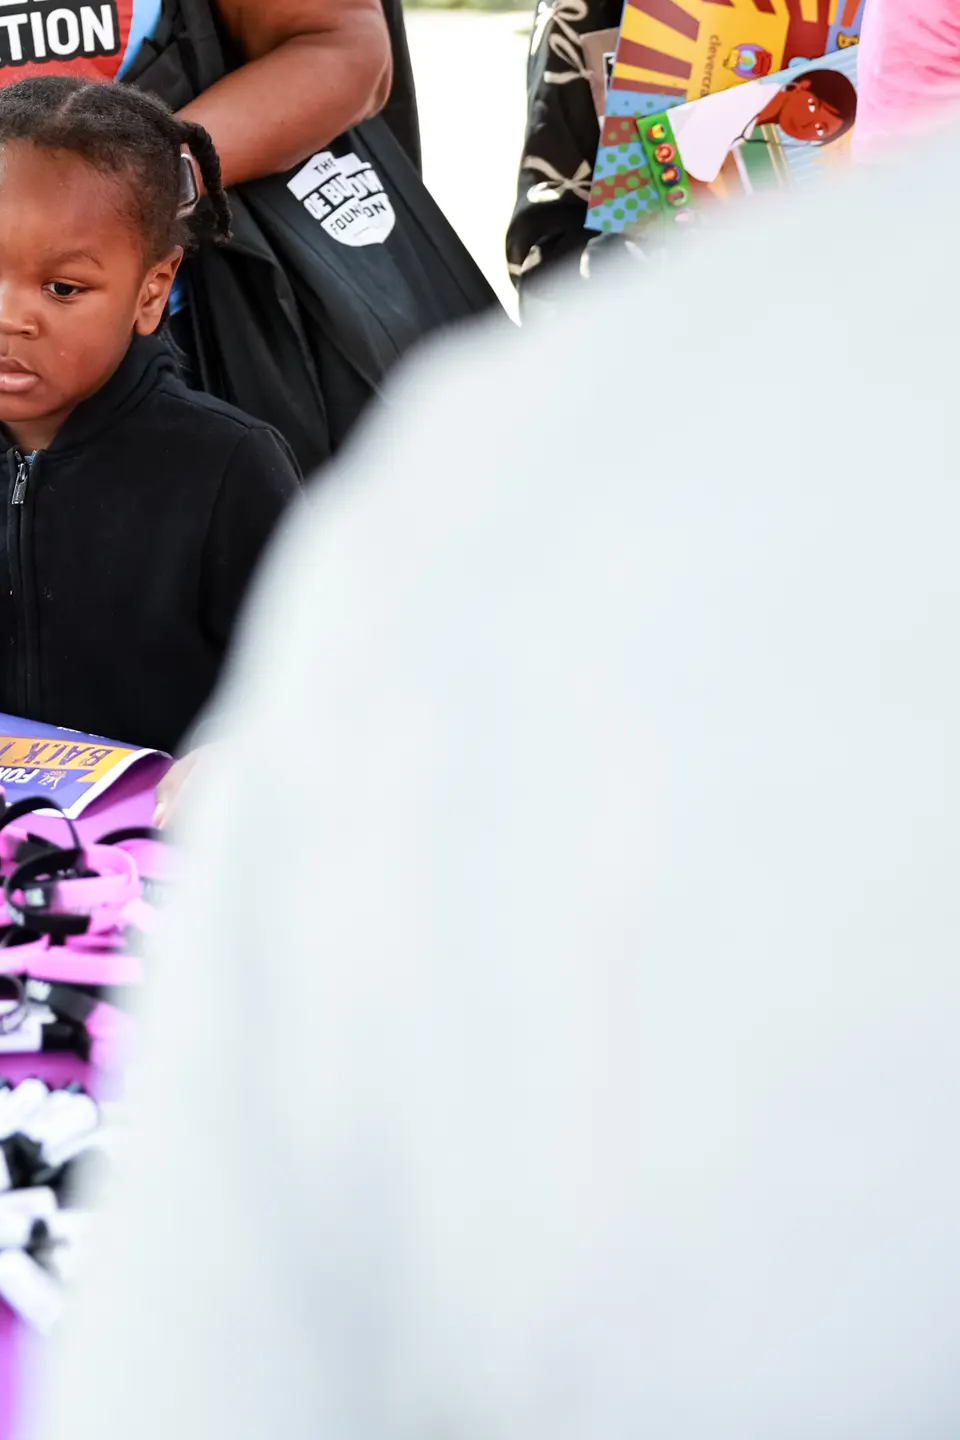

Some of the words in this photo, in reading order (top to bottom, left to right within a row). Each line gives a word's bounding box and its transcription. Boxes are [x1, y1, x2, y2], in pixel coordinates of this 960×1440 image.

[313, 157, 337, 176] THE
[329, 199, 387, 236] FOUNON
[18, 740, 115, 767] BACK
